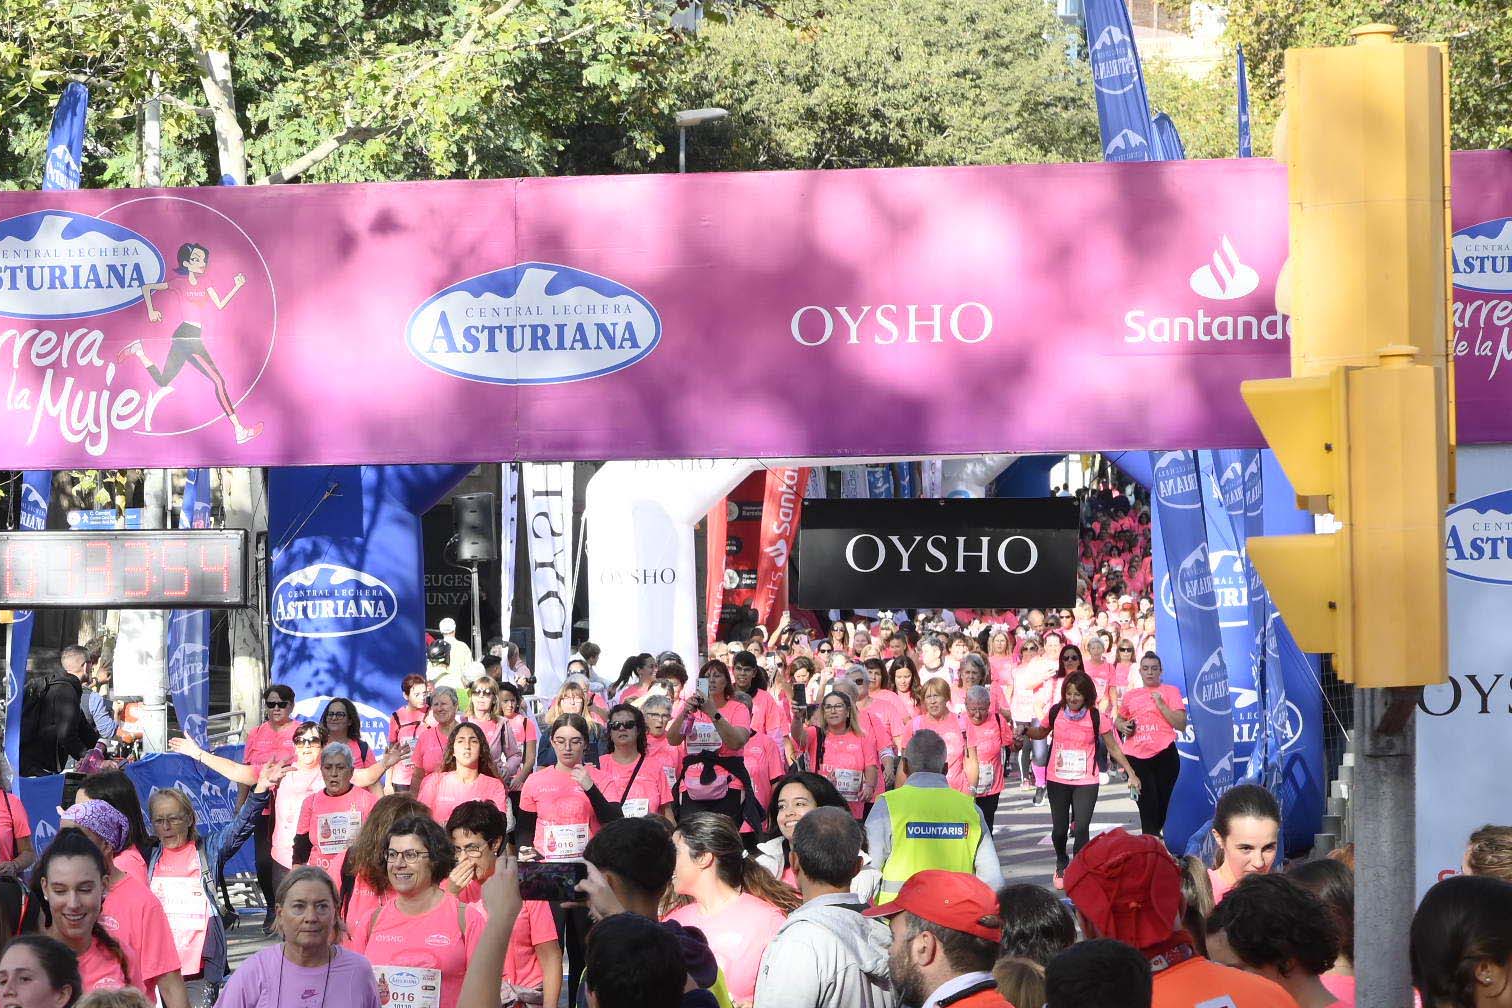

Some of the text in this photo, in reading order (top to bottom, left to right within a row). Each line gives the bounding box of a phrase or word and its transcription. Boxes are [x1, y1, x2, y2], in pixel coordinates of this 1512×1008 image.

[67, 245, 141, 259] LECHERA
[465, 304, 633, 319] CENTRAL LECHERA
[791, 302, 994, 347] OYSHO
[427, 310, 641, 355] ASTURIANA
[1475, 328, 1493, 357] la
[5, 384, 32, 411] la
[27, 363, 173, 456] Mujer
[845, 533, 1039, 575] OYSHO
[274, 592, 389, 621] ASTURIANA
[288, 588, 384, 599] CENTRAL LECHERA
[907, 826, 963, 836] VOLUNTARIS
[391, 992, 415, 1002] 016
